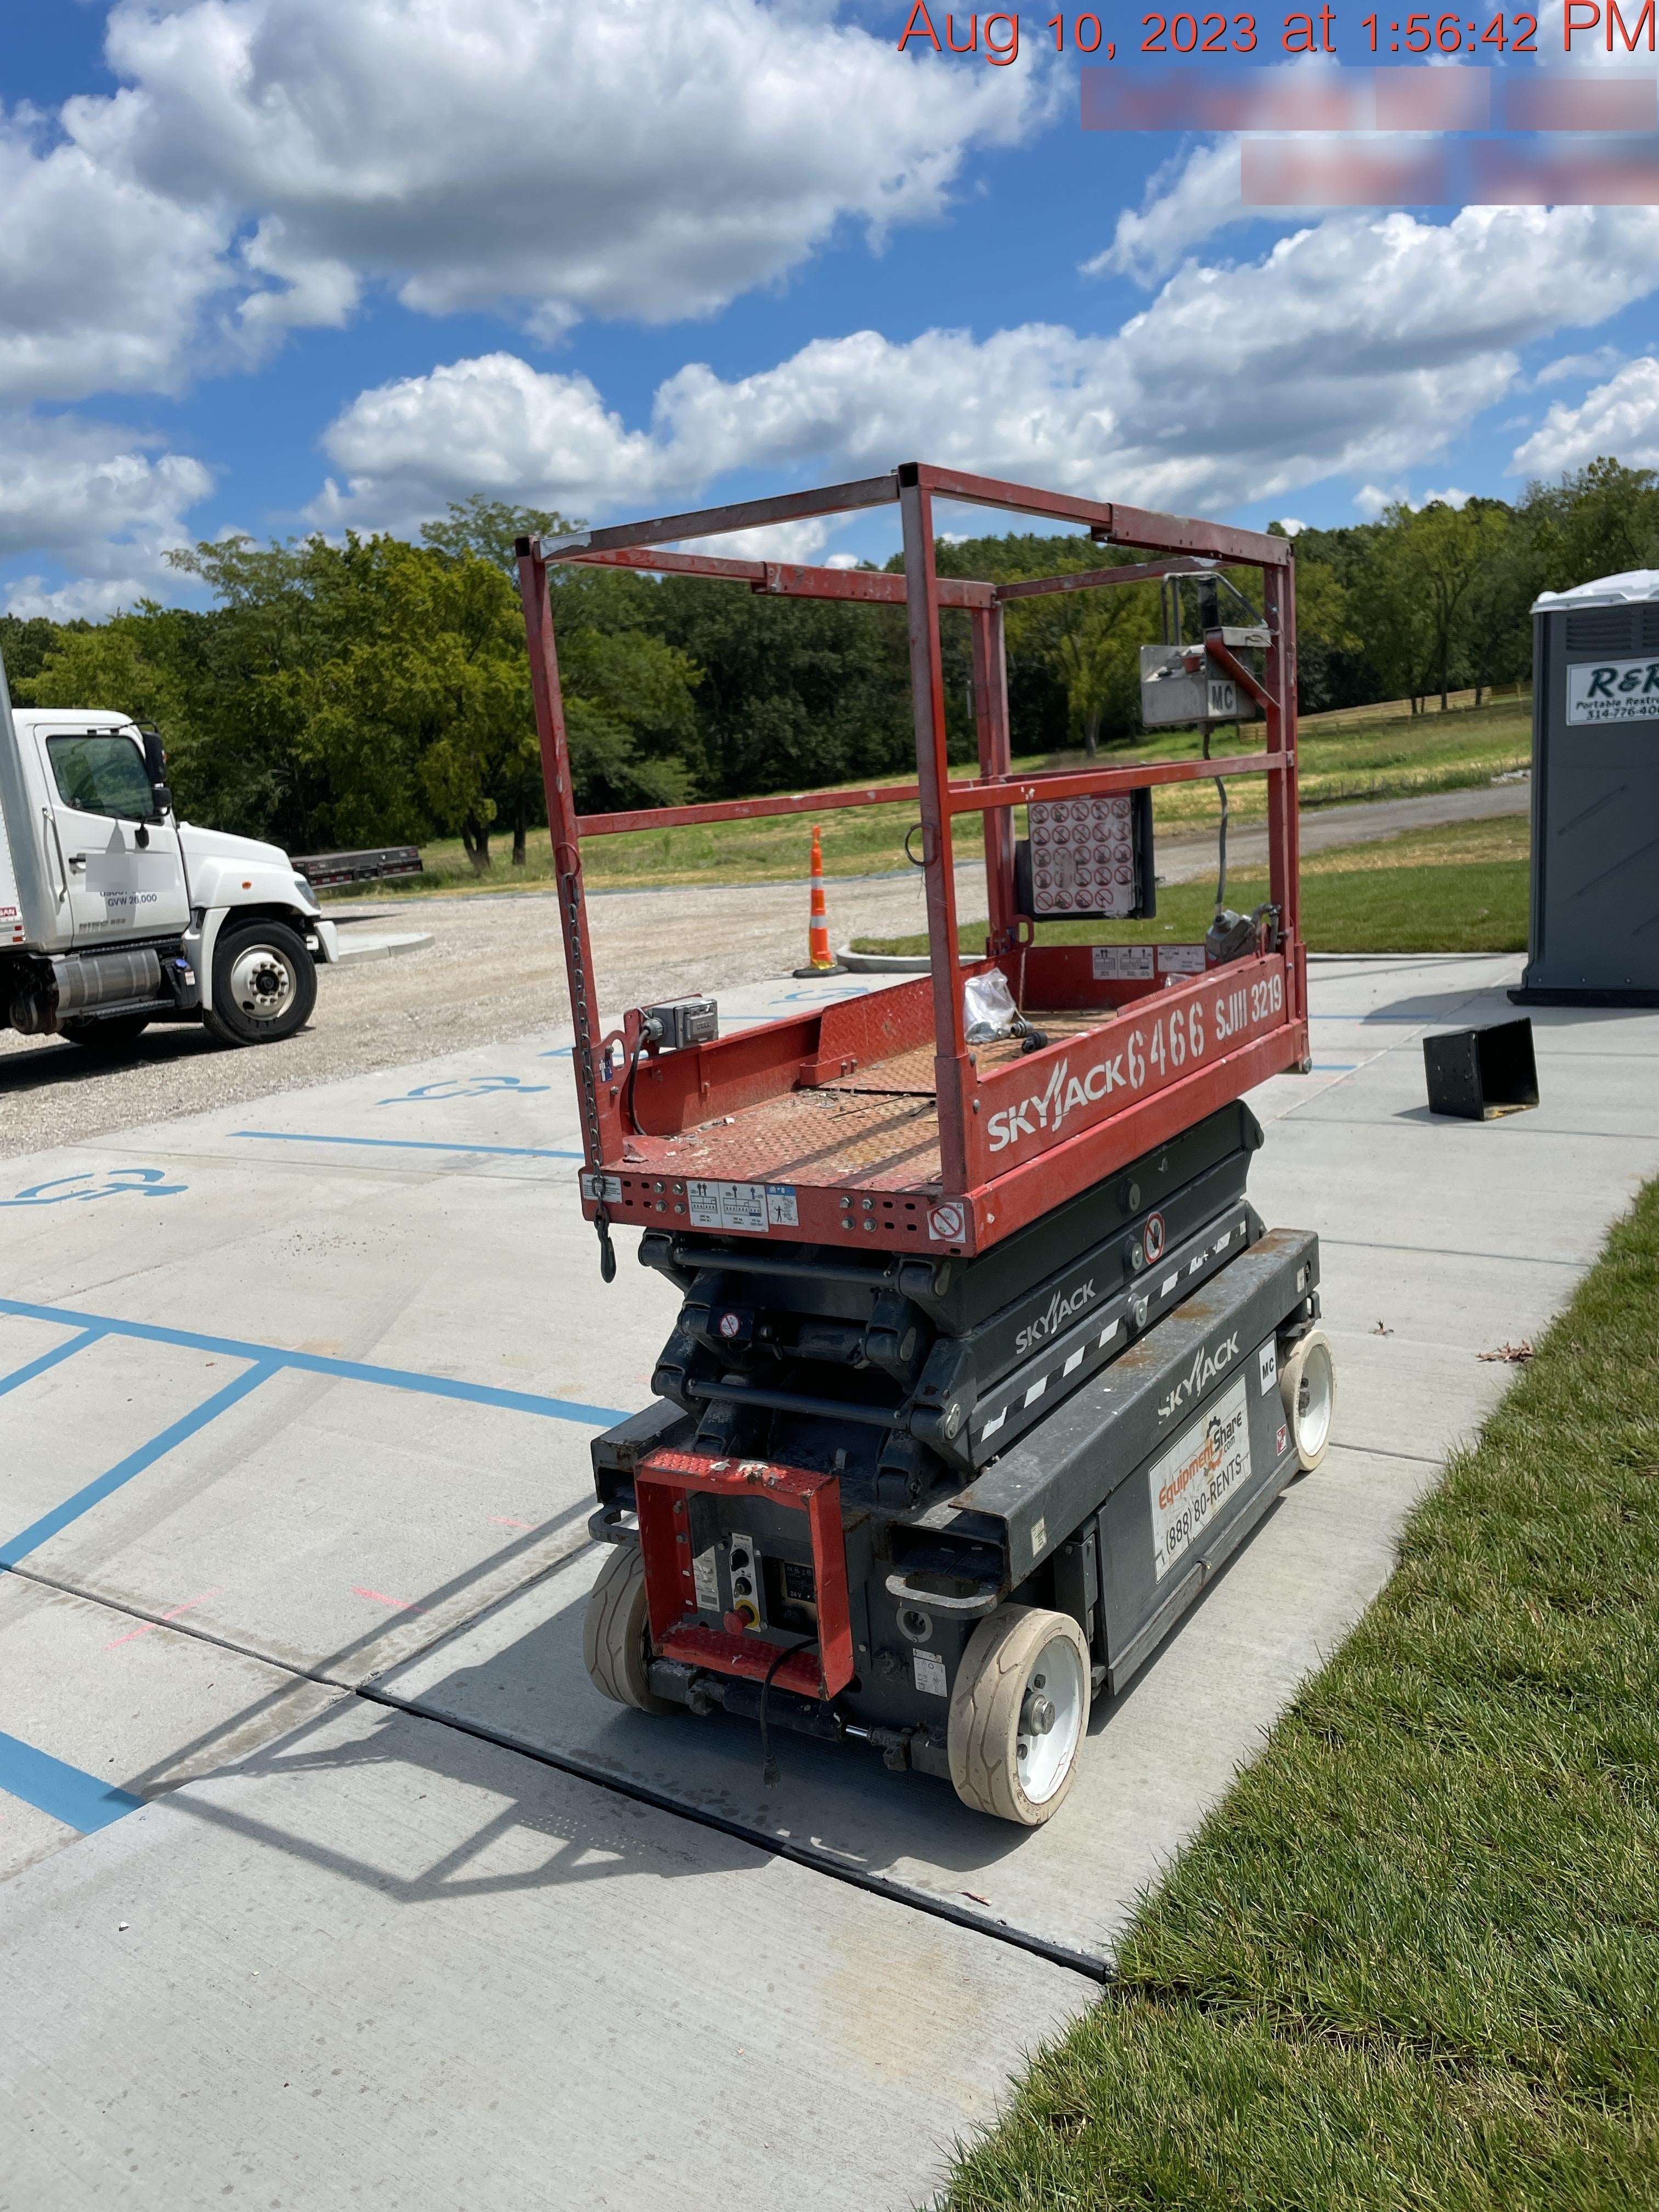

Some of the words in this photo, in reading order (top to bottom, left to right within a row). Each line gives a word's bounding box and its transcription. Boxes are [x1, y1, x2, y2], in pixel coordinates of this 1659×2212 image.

[1211, 685, 1233, 710] MC
[988, 1054, 1127, 1152] SKYJACK
[1128, 1001, 1204, 1089] 6466
[1216, 989, 1247, 1040] SJIII
[1251, 974, 1282, 1023] 3219
[1015, 1278, 1096, 1355] SKYJACK
[1158, 1330, 1239, 1425] SKYJACK
[1262, 1357, 1274, 1381] MC
[1166, 1507, 1192, 1555] (888)
[1194, 1453, 1242, 1522] 80-RENTS
